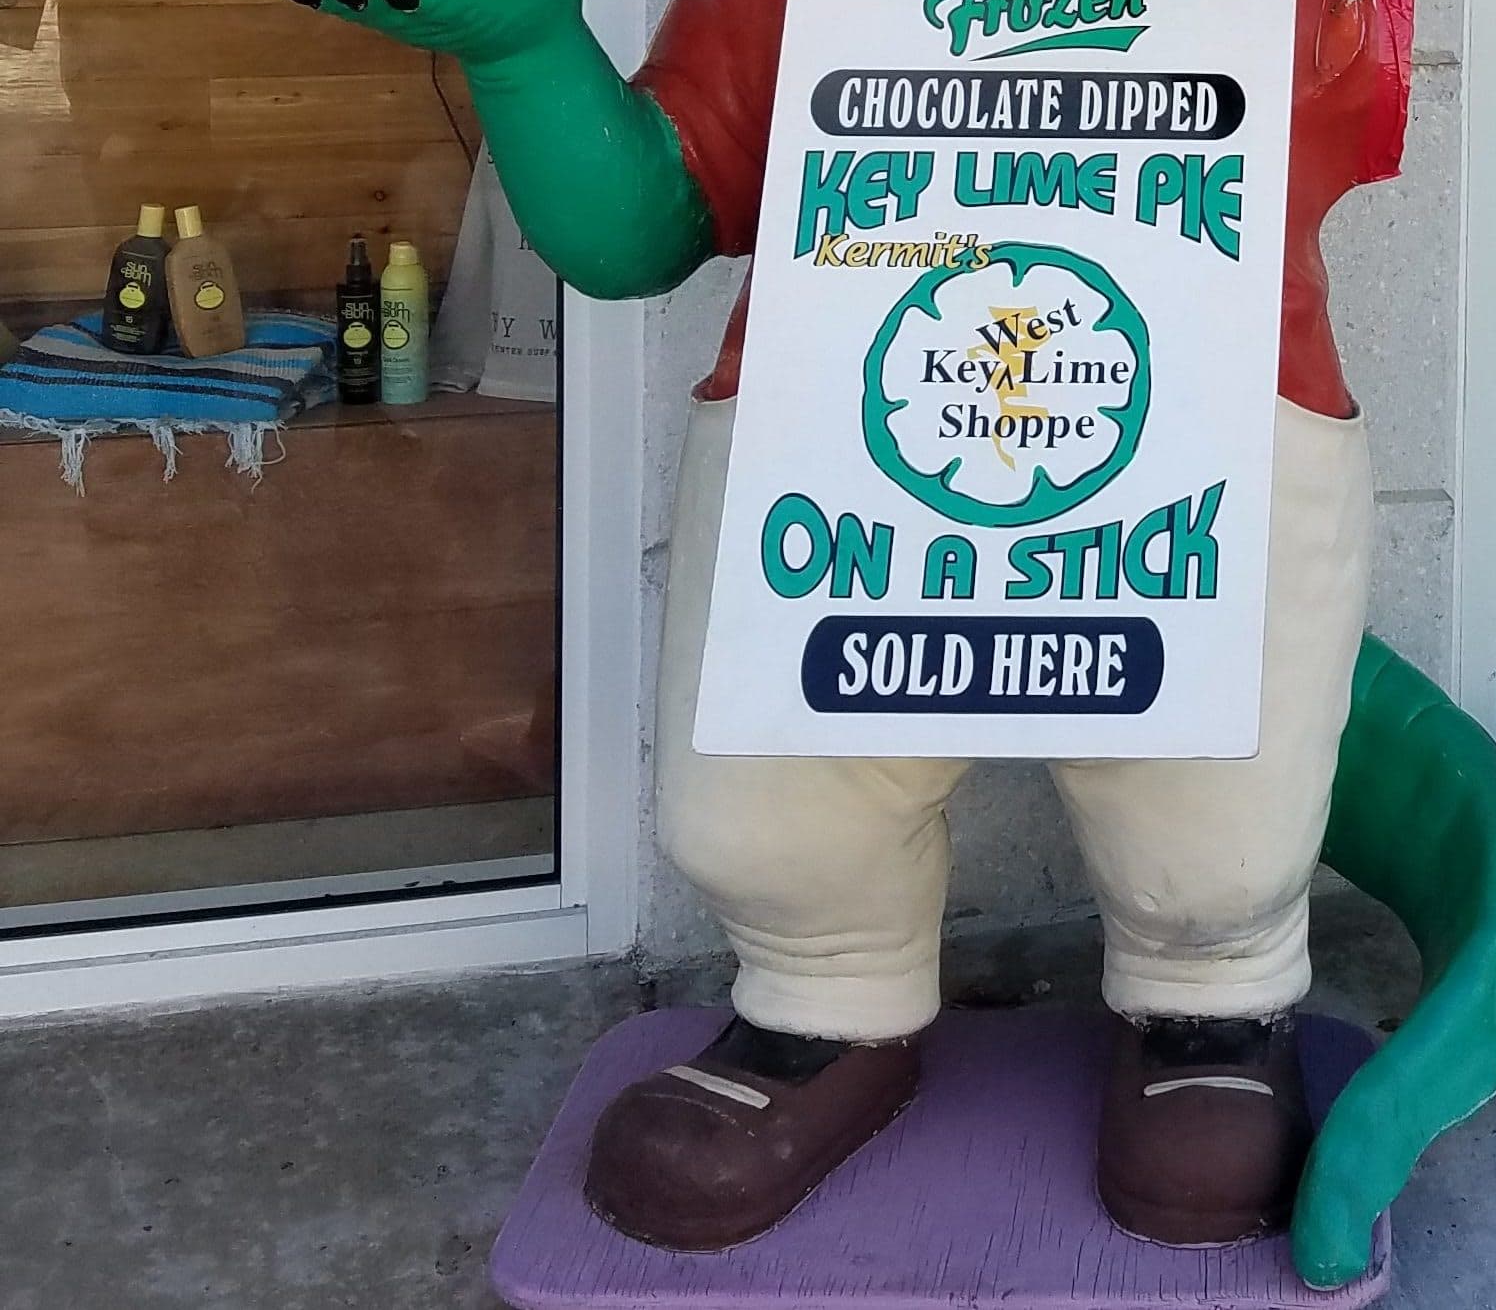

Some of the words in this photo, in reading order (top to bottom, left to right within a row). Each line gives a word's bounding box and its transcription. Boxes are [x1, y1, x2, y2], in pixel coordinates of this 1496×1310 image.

[838, 77, 1061, 132] CHOCOLATE
[1079, 80, 1219, 133] DIPPED
[792, 149, 935, 263] KEY
[953, 149, 1118, 216] LIME
[1135, 151, 1245, 263] PIE
[814, 231, 993, 270] Kermit's
[976, 298, 1082, 352] West
[921, 348, 998, 394] Key
[1020, 348, 1130, 387] Lime
[938, 403, 1096, 450] Shoppe
[760, 491, 896, 601] ON
[919, 533, 977, 598] A
[1004, 478, 1228, 602] STICK
[838, 632, 975, 697] SOLD
[992, 632, 1128, 697] HERE
